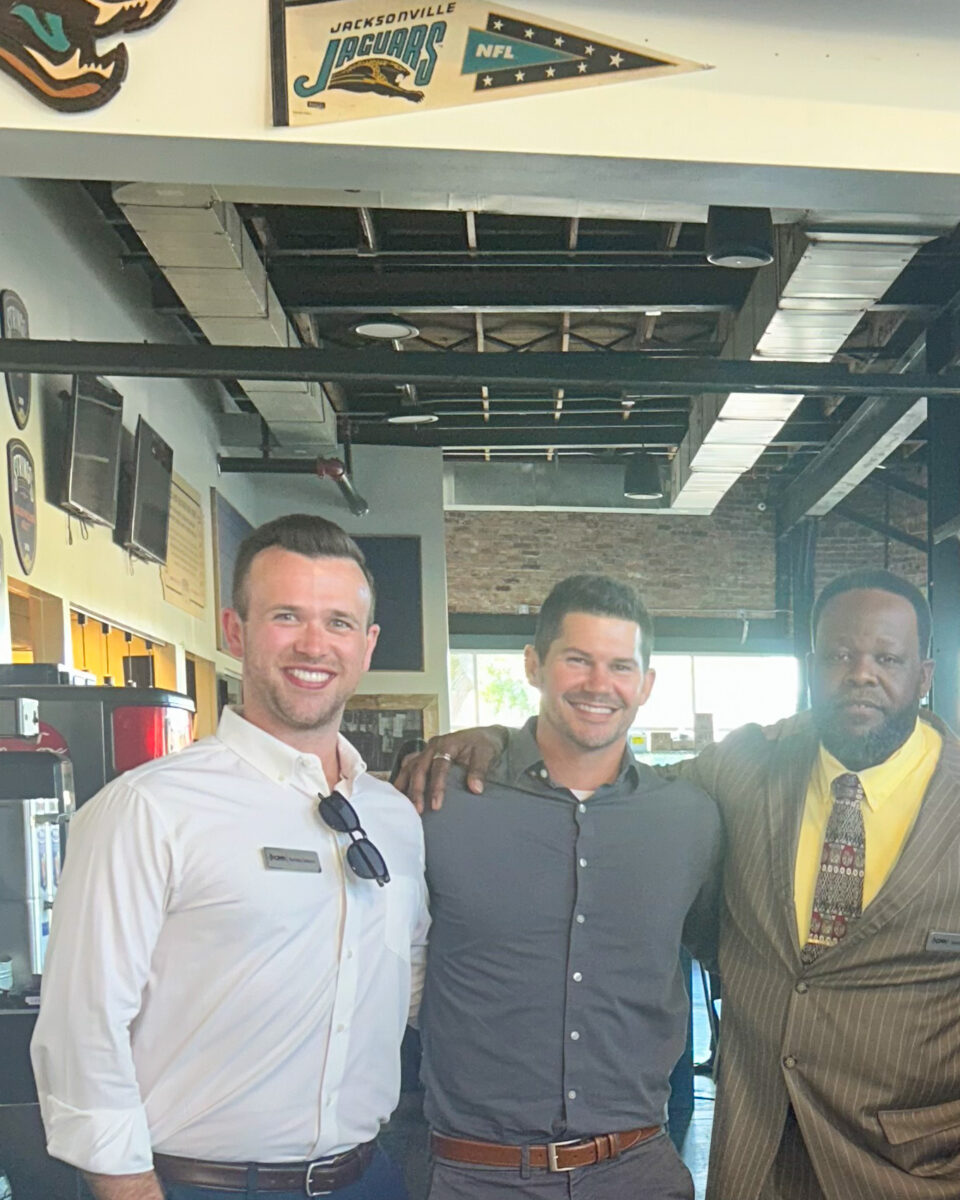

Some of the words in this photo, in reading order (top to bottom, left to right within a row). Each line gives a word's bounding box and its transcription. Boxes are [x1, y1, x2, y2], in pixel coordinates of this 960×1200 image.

[330, 2, 457, 34] JACKSONVILLE
[294, 20, 448, 98] JAGUARS
[475, 43, 515, 59] NFL
